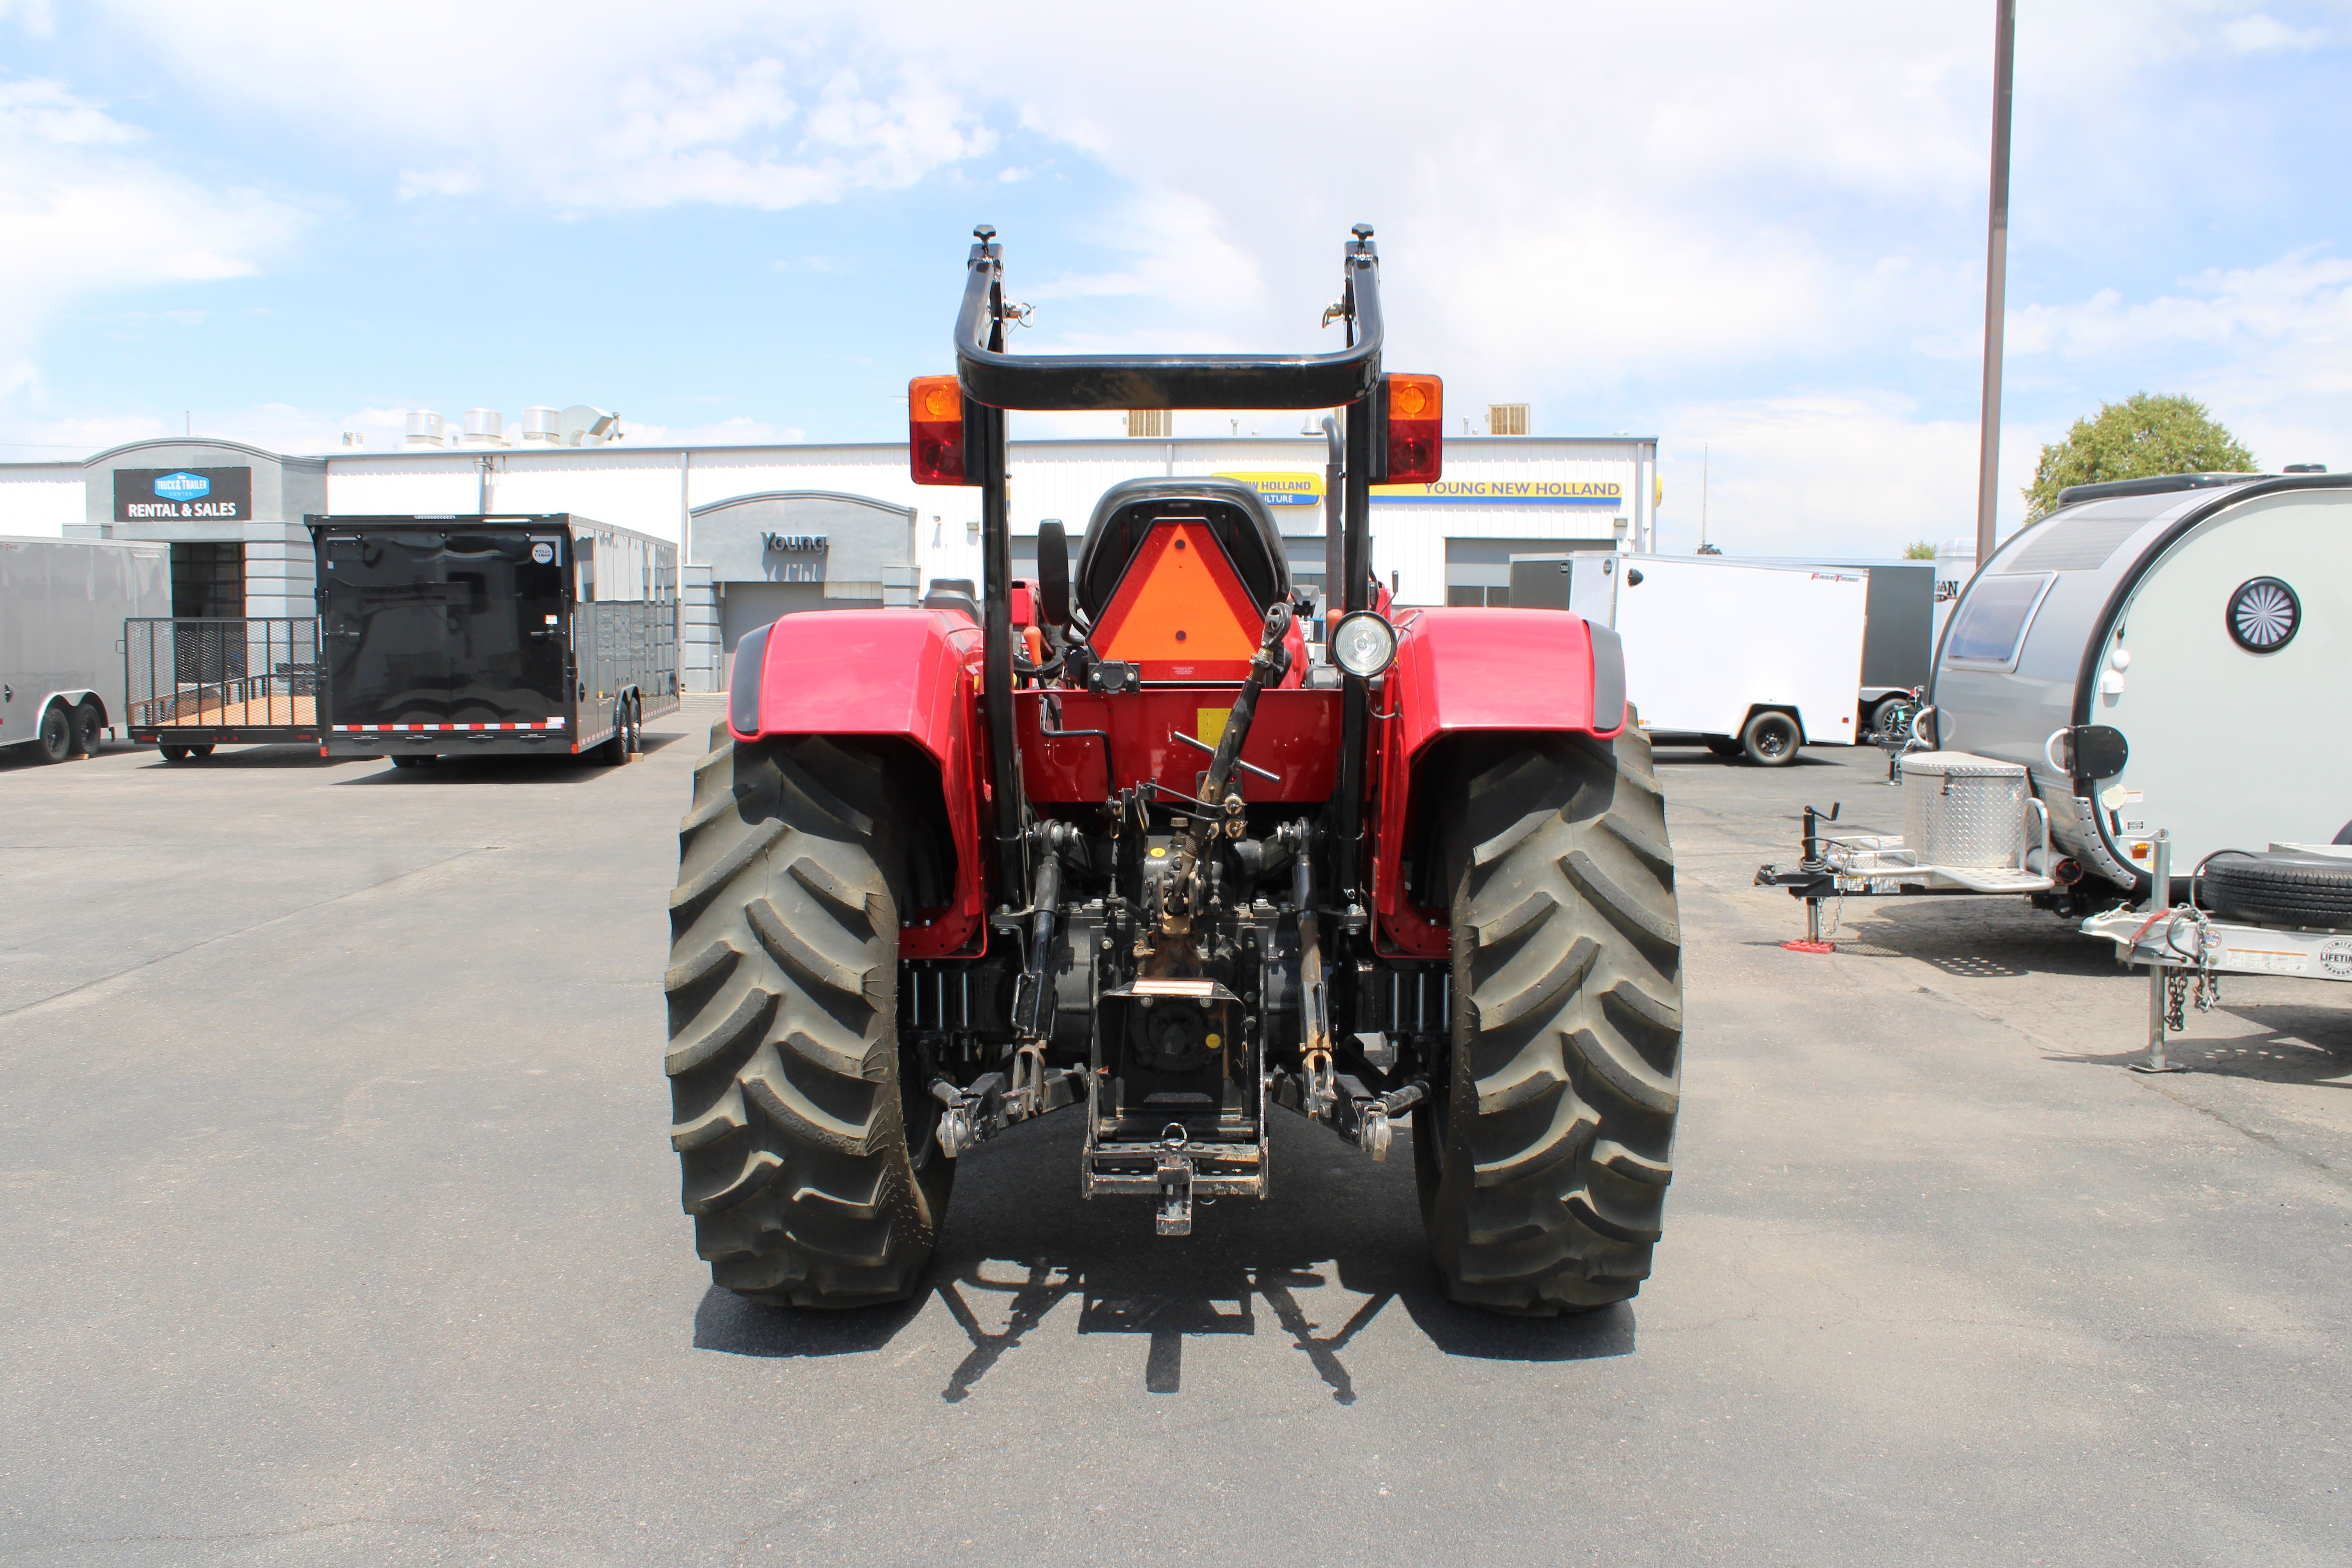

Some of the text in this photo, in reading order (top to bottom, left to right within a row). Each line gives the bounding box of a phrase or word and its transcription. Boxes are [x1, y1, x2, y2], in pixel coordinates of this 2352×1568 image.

[157, 479, 207, 490] TRUCK & TRAILER
[1261, 481, 1311, 490] HOLLAND
[1425, 482, 1620, 495] YOUNG NEW HOLLAND
[128, 502, 236, 518] RENTAL & SALES
[760, 532, 826, 555] Young
